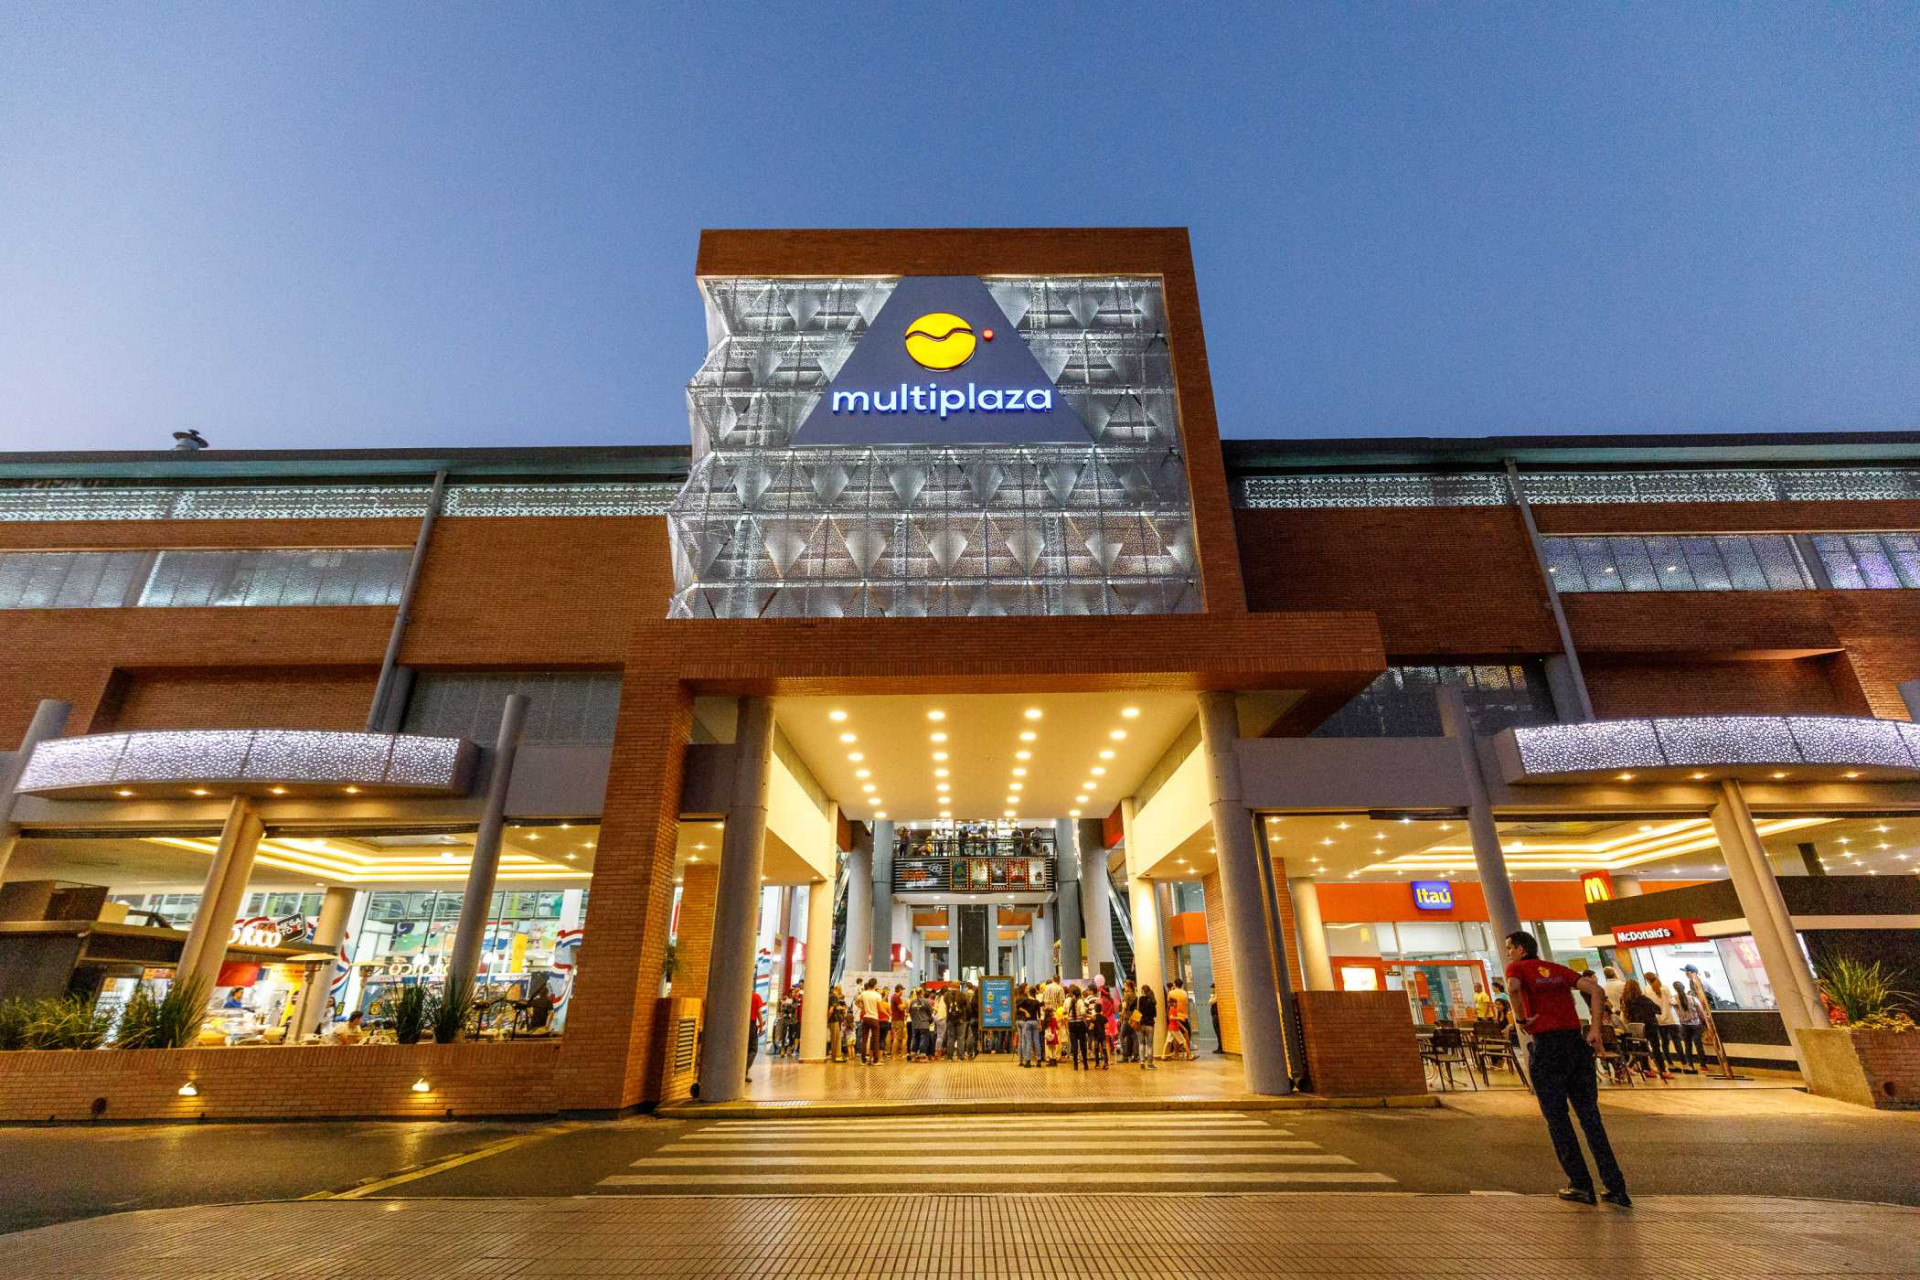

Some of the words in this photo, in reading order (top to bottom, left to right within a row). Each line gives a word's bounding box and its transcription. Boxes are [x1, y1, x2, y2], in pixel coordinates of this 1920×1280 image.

[832, 382, 1052, 418] multiplaza
[1416, 888, 1452, 903] Itaú
[1616, 927, 1671, 942] McDonald's
